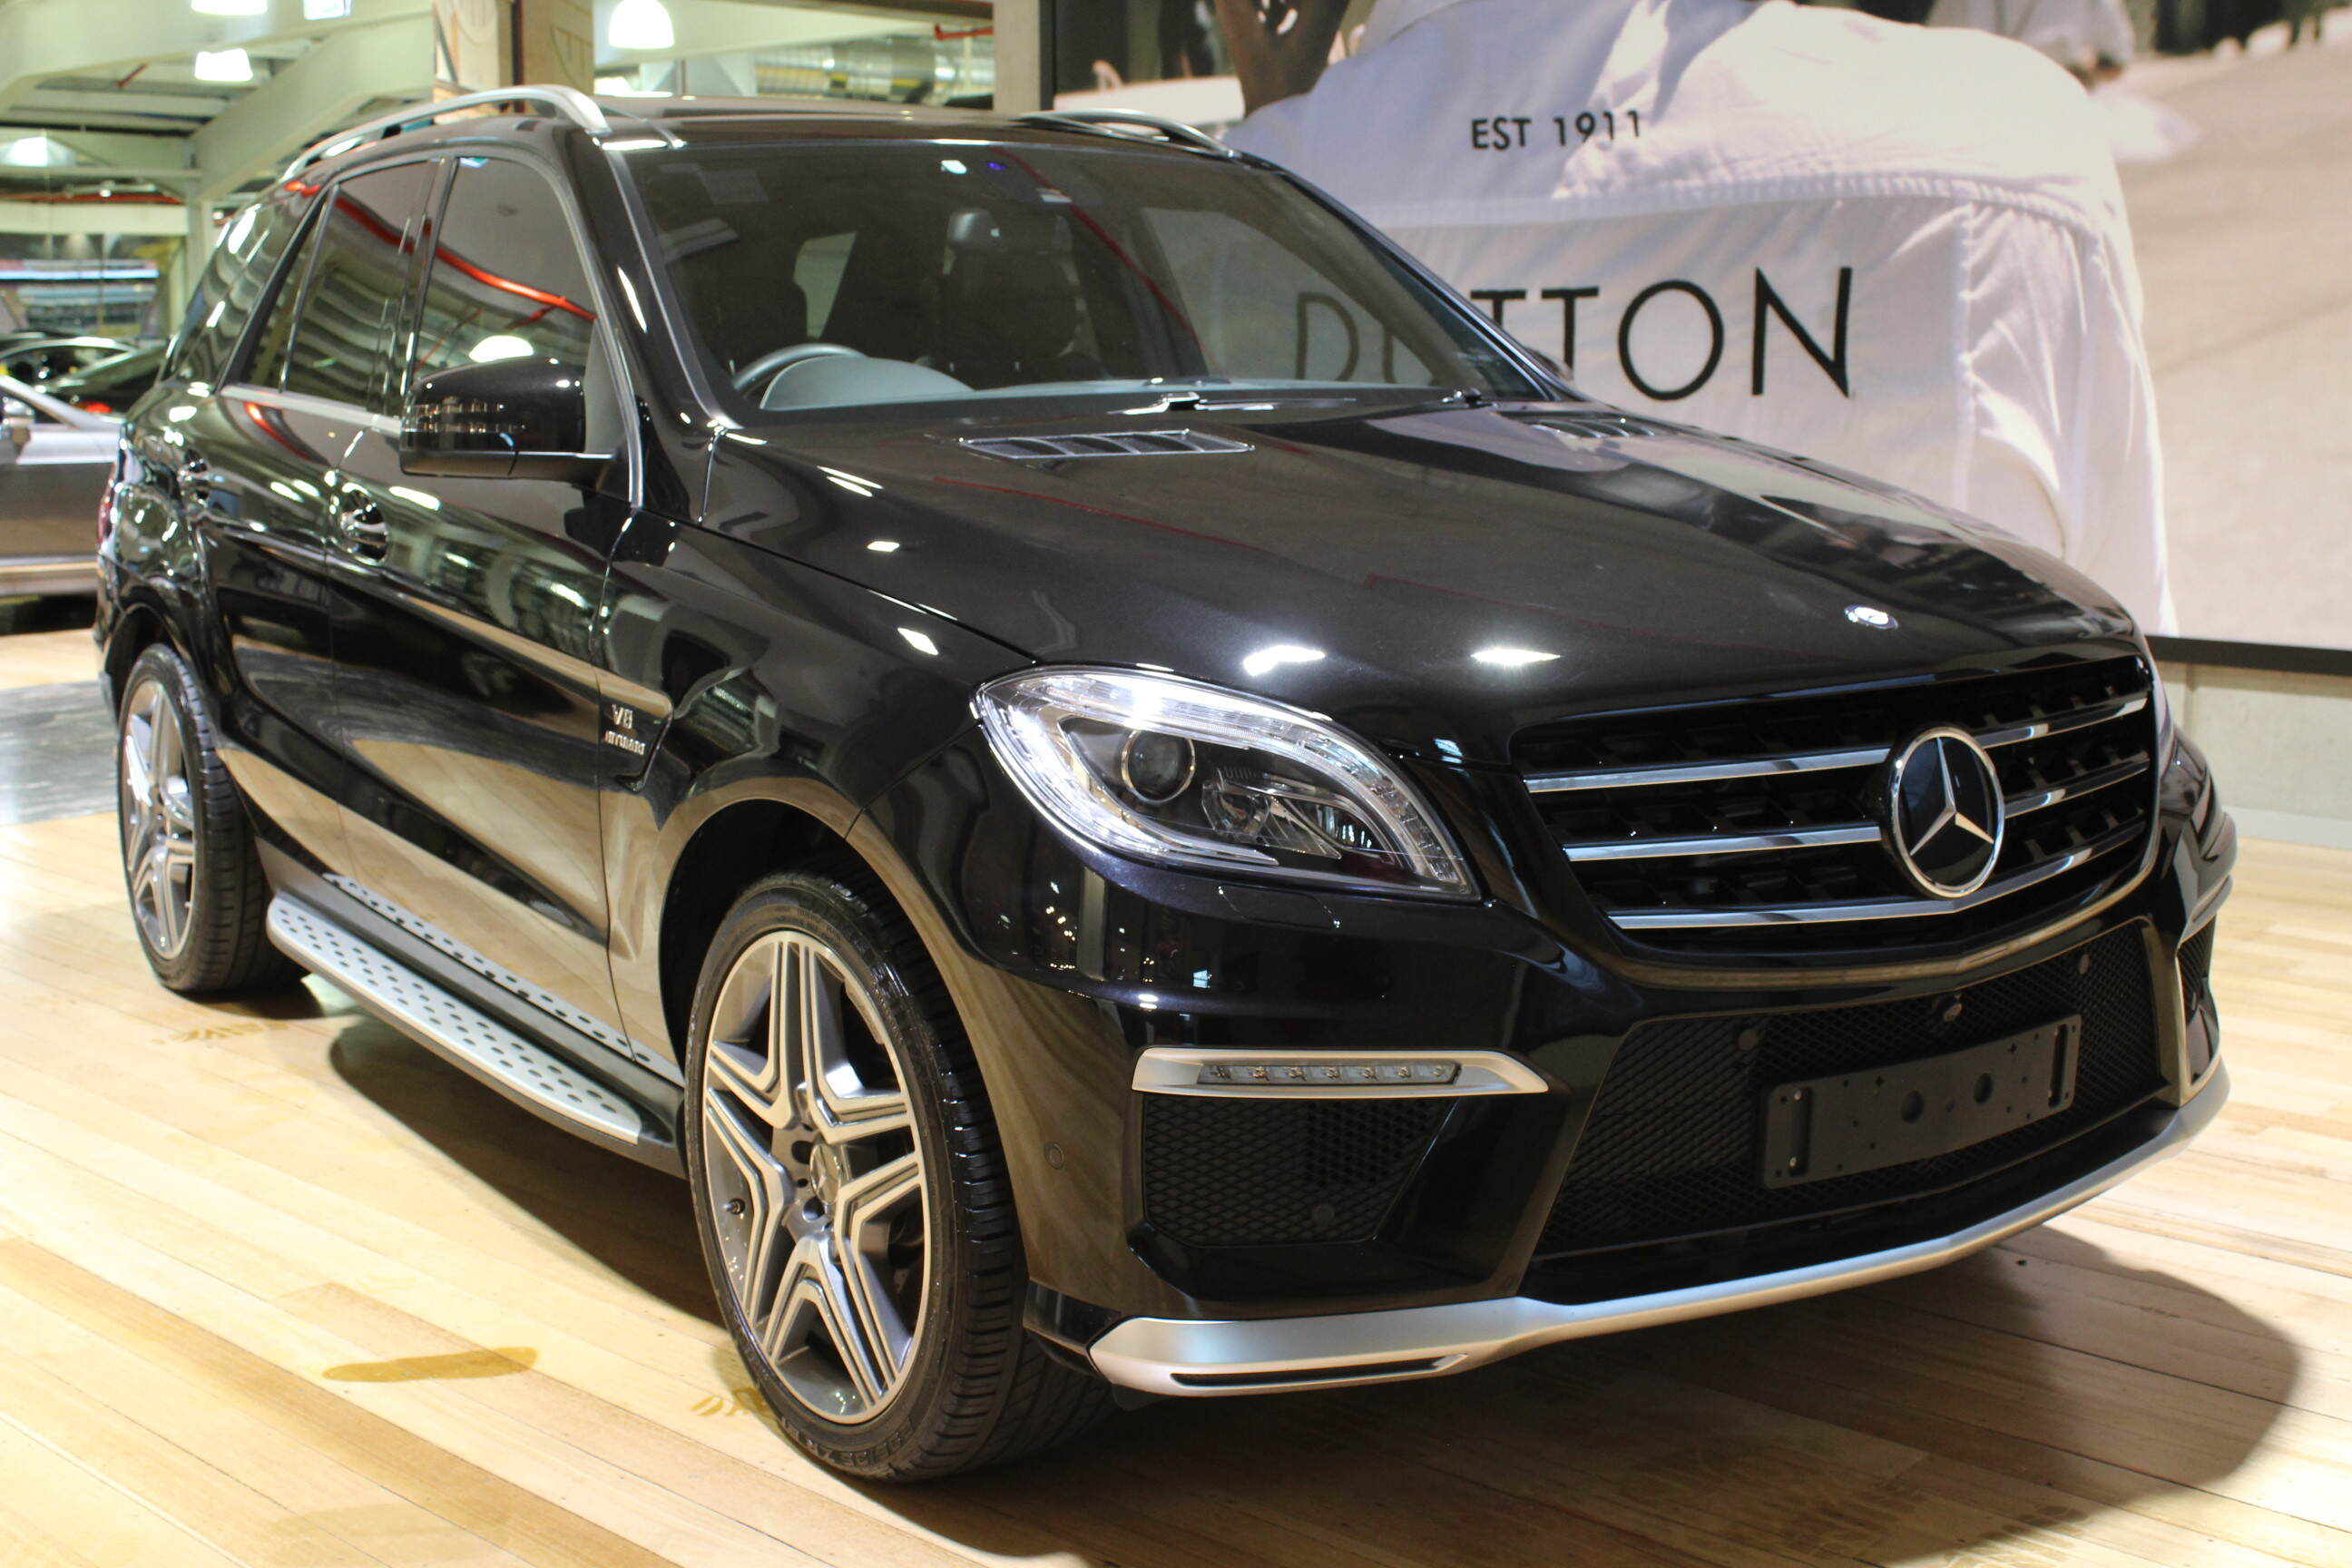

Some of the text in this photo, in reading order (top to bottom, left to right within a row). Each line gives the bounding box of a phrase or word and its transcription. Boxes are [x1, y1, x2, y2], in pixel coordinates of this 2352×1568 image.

[1471, 110, 1642, 151] EST 1911
[612, 703, 633, 730] V8
